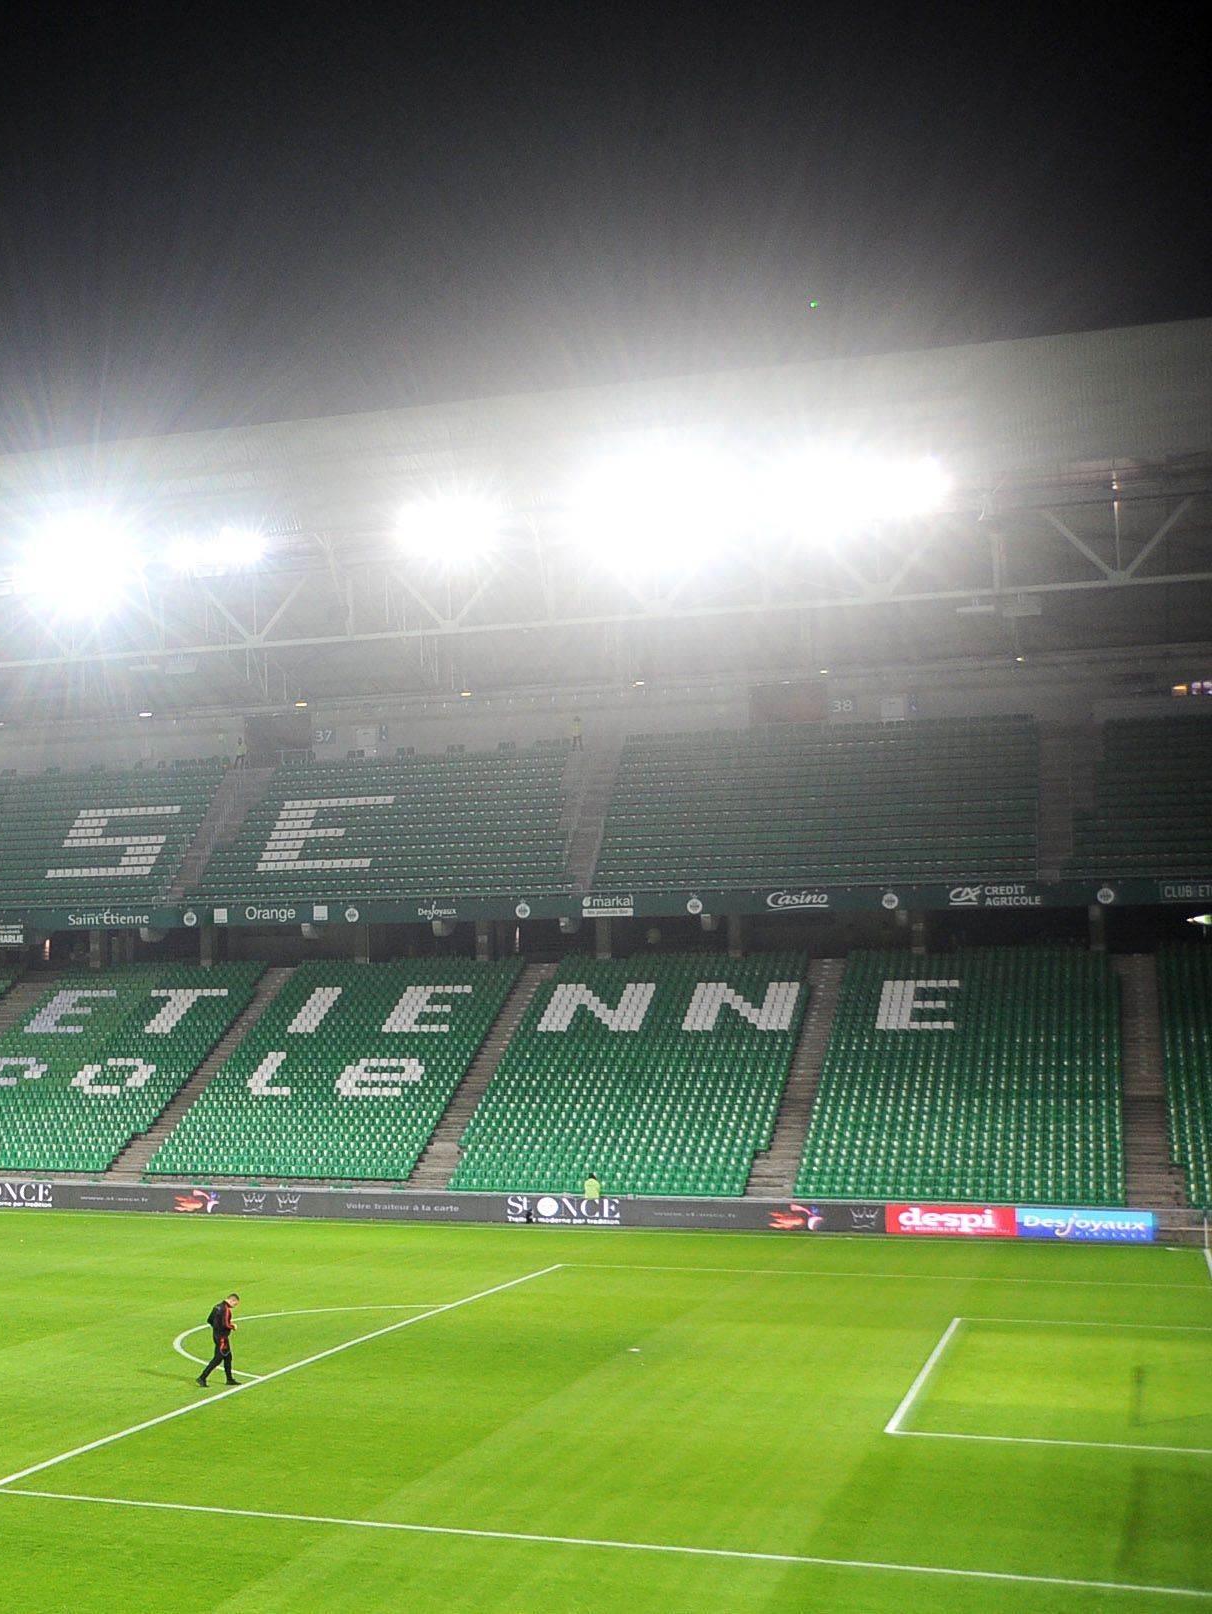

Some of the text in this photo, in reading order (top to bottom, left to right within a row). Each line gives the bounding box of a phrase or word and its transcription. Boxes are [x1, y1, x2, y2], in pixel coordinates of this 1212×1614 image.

[833, 700, 852, 711] 38
[315, 730, 333, 742] 37
[1164, 885, 1192, 898] CLUB
[592, 895, 634, 907] markal
[766, 890, 829, 908] Casino
[985, 895, 1042, 906] AGRICOLE
[245, 906, 296, 923] Orange
[345, 1202, 371, 1210] Votre
[433, 1205, 460, 1213] carte
[898, 1207, 997, 1233] despi
[1023, 1211, 1146, 1237] Desjoyaux
